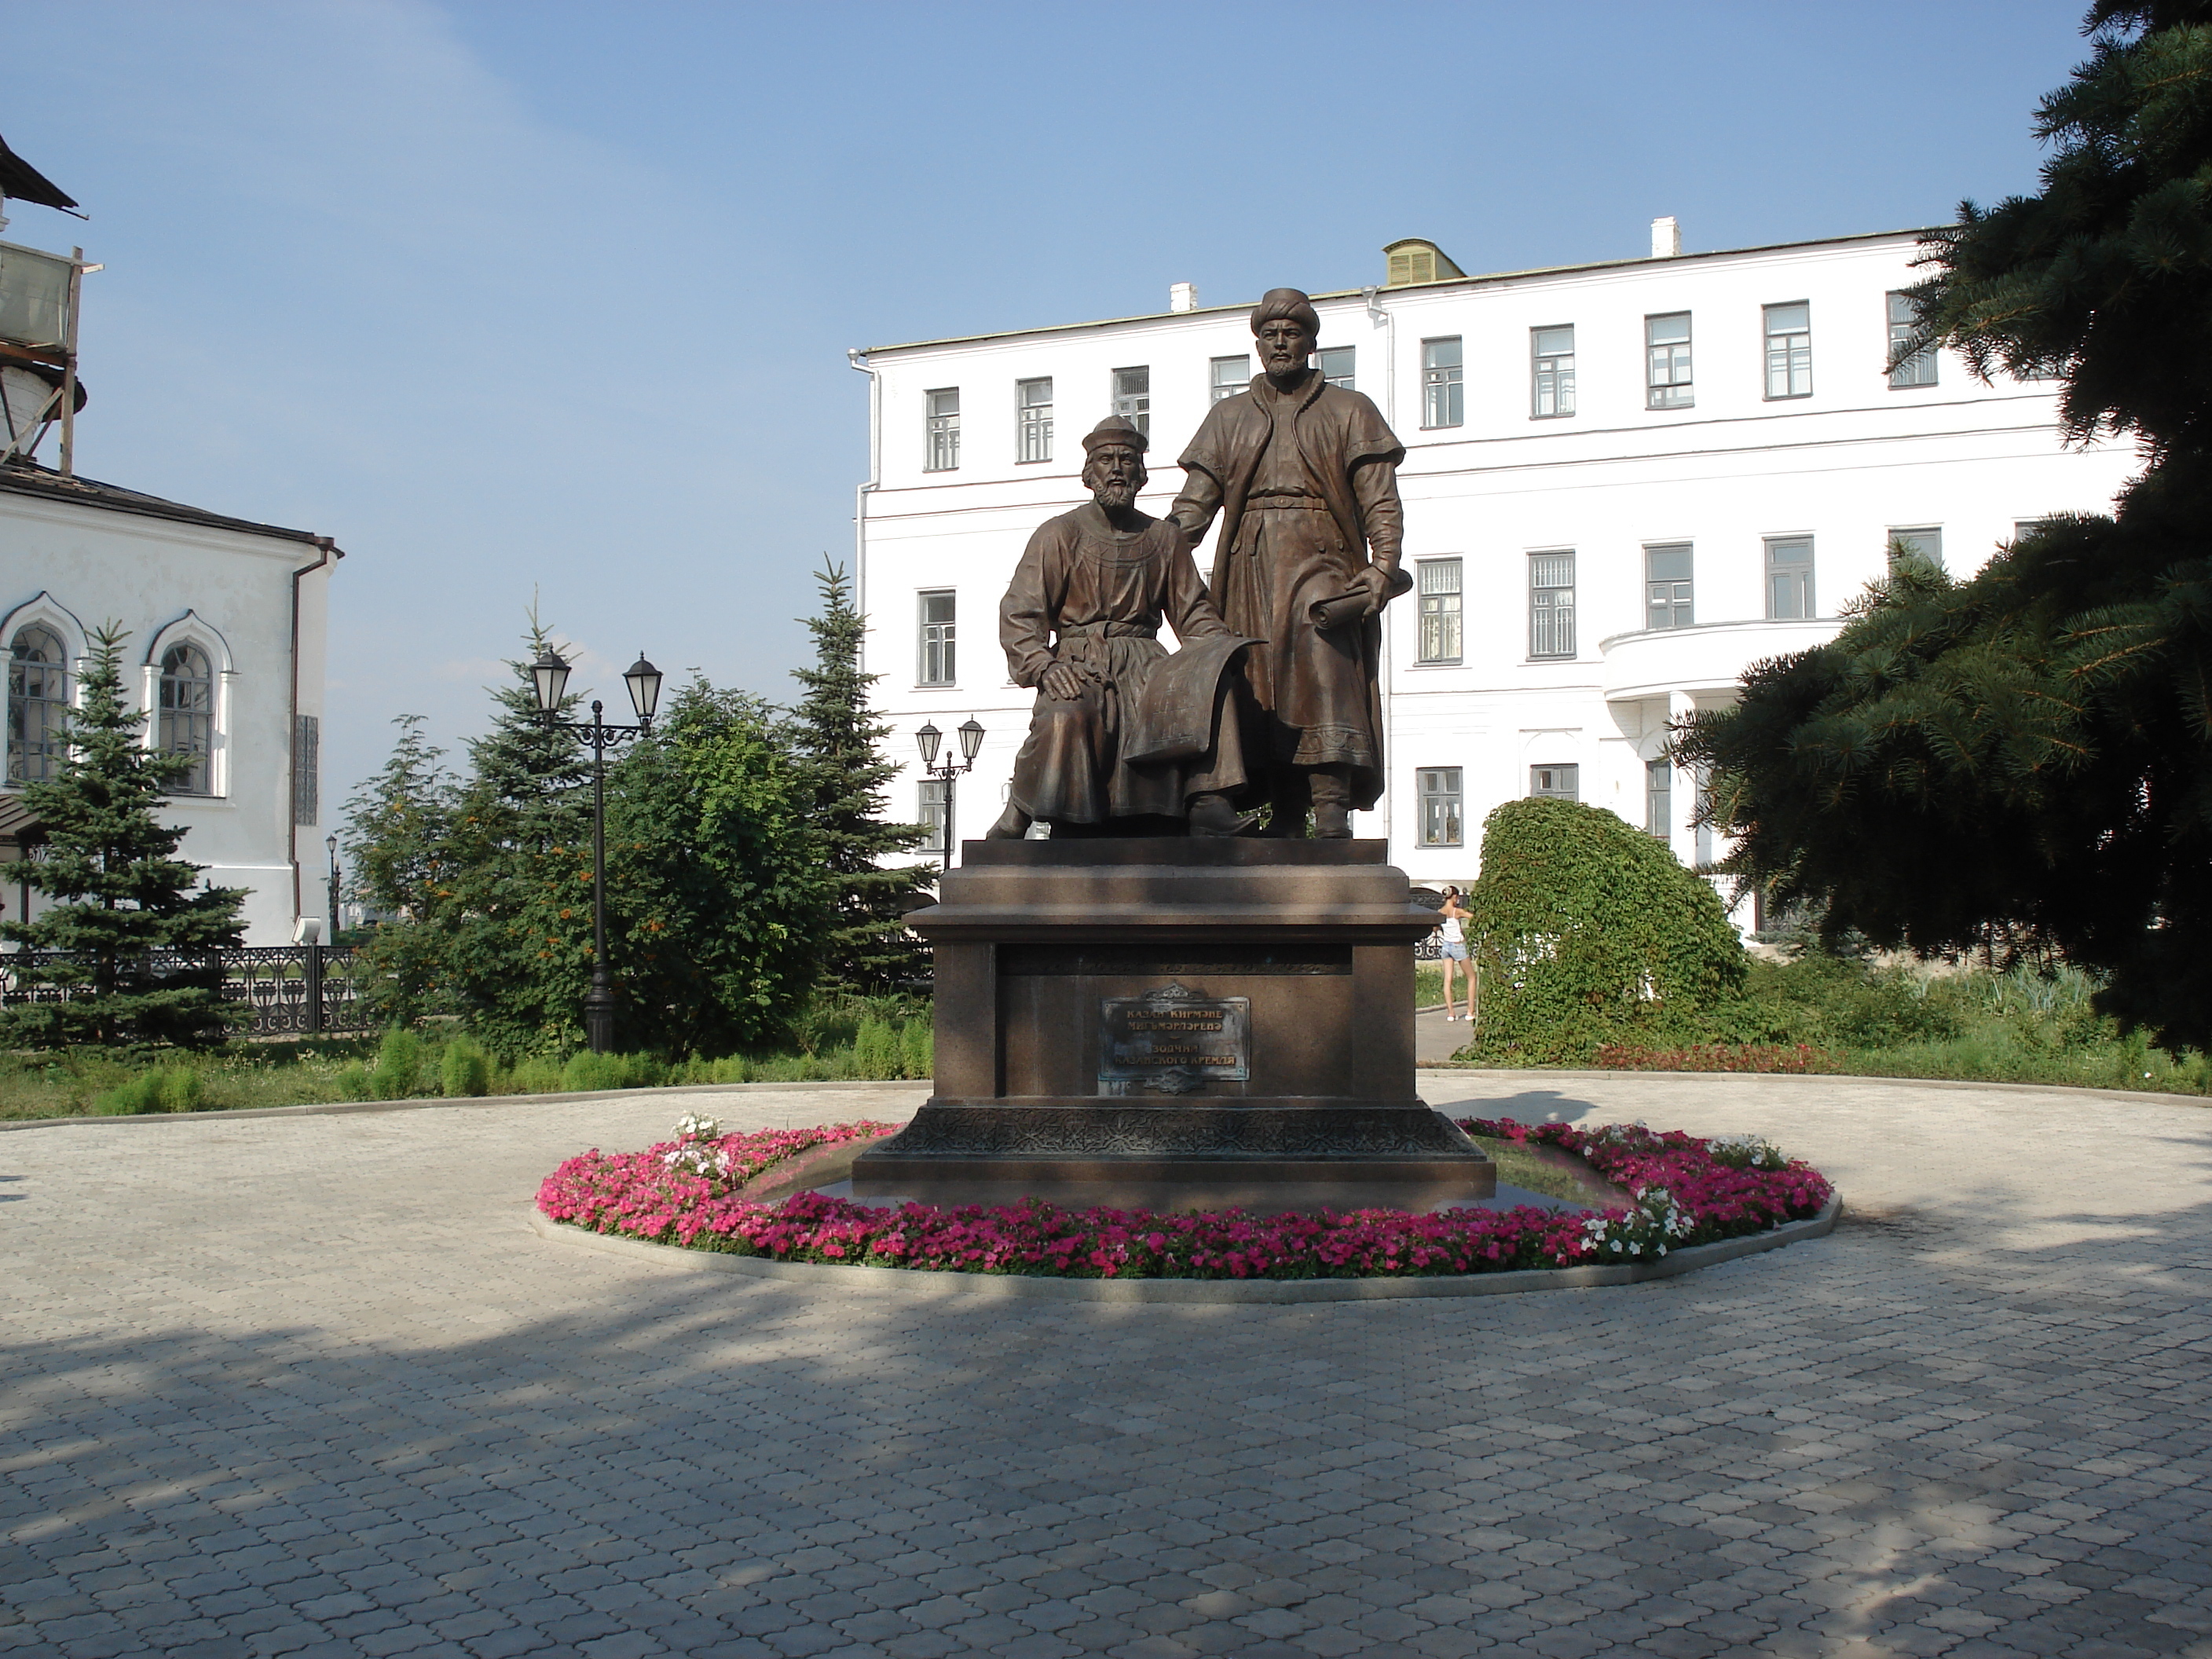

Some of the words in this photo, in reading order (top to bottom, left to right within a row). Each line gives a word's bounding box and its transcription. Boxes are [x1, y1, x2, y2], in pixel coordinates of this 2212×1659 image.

[1126, 1010, 1164, 1019] КАЗАН
[1152, 1044, 1199, 1053] ЗОДЧИМ
[1115, 1056, 1187, 1065] КАЗАНСКОГО
[1191, 1055, 1236, 1065] КРЕМЛЯ
